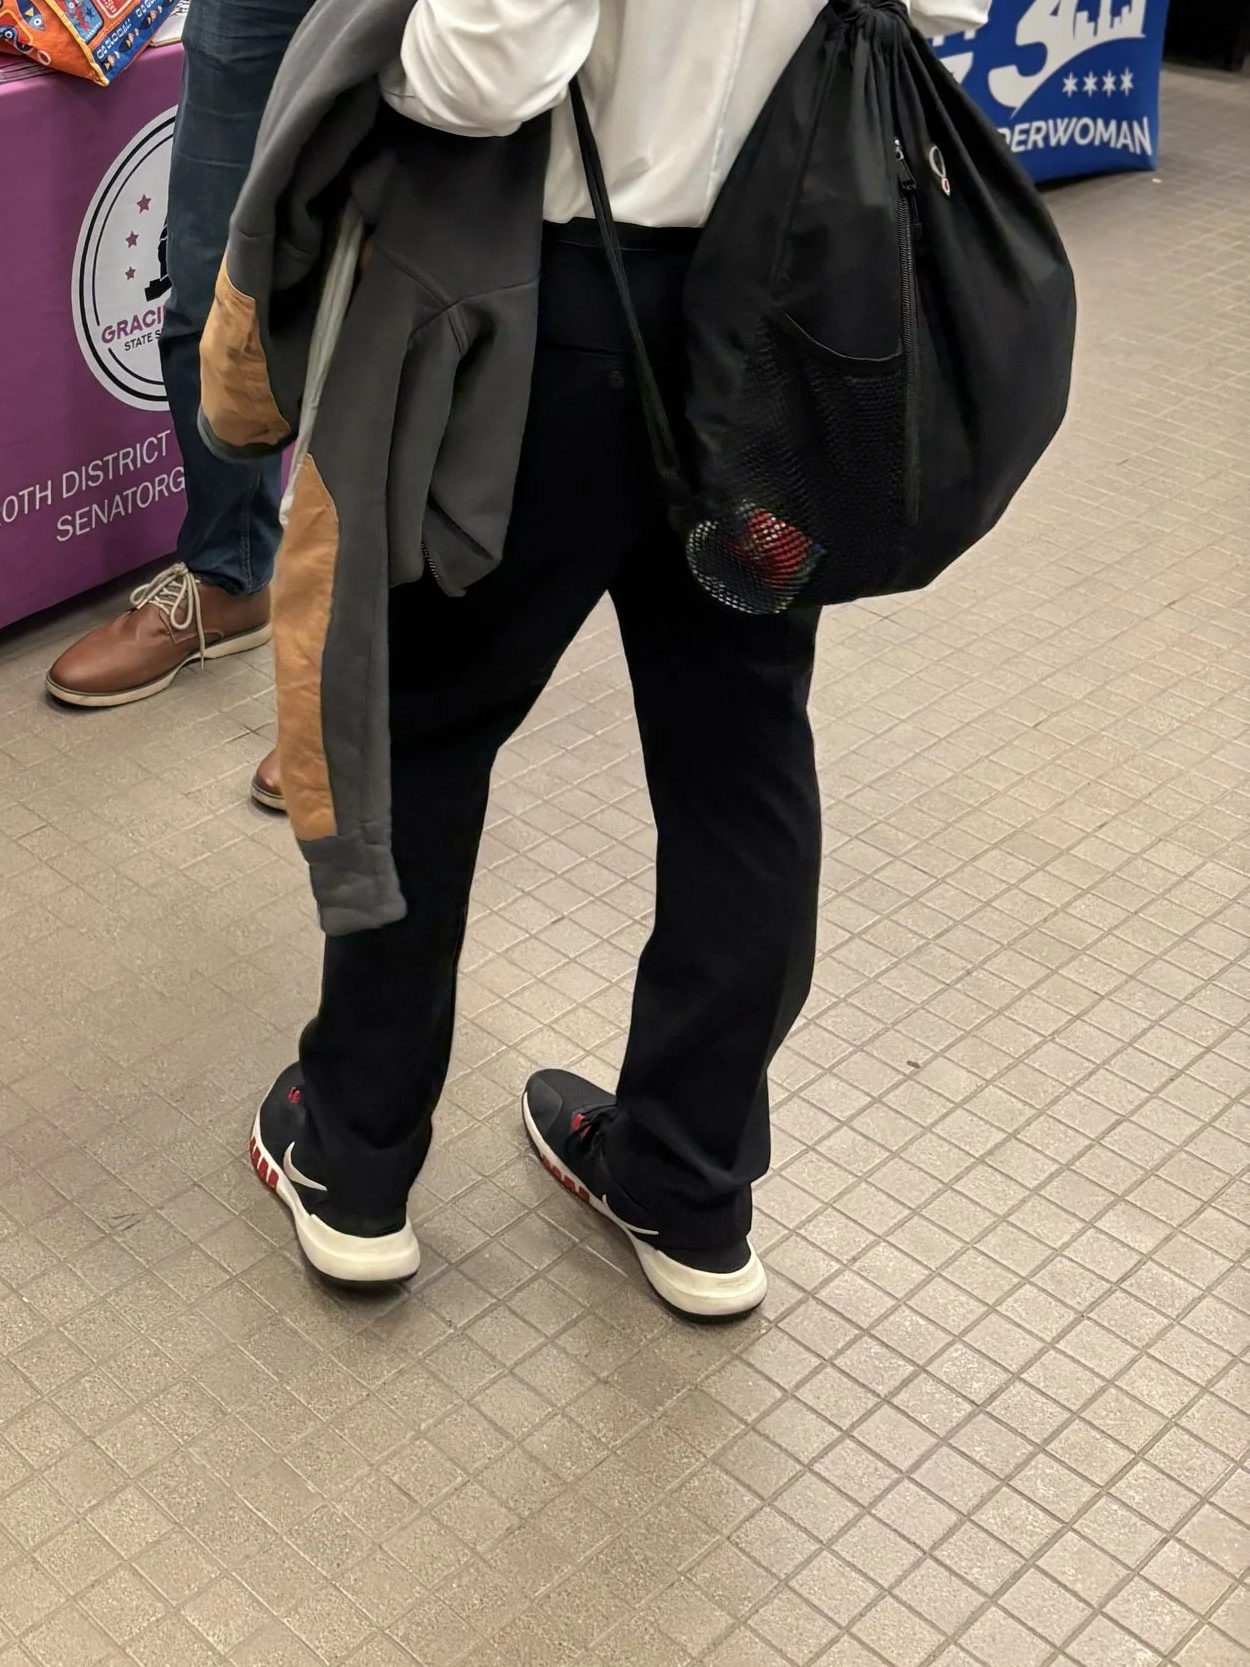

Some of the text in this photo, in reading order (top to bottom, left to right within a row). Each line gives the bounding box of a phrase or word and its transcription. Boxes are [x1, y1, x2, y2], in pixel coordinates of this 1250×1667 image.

[101, 304, 166, 344] GRACI
[124, 332, 153, 351] STATE
[62, 429, 172, 499] DISTRICT
[56, 465, 186, 542] SENATORG
